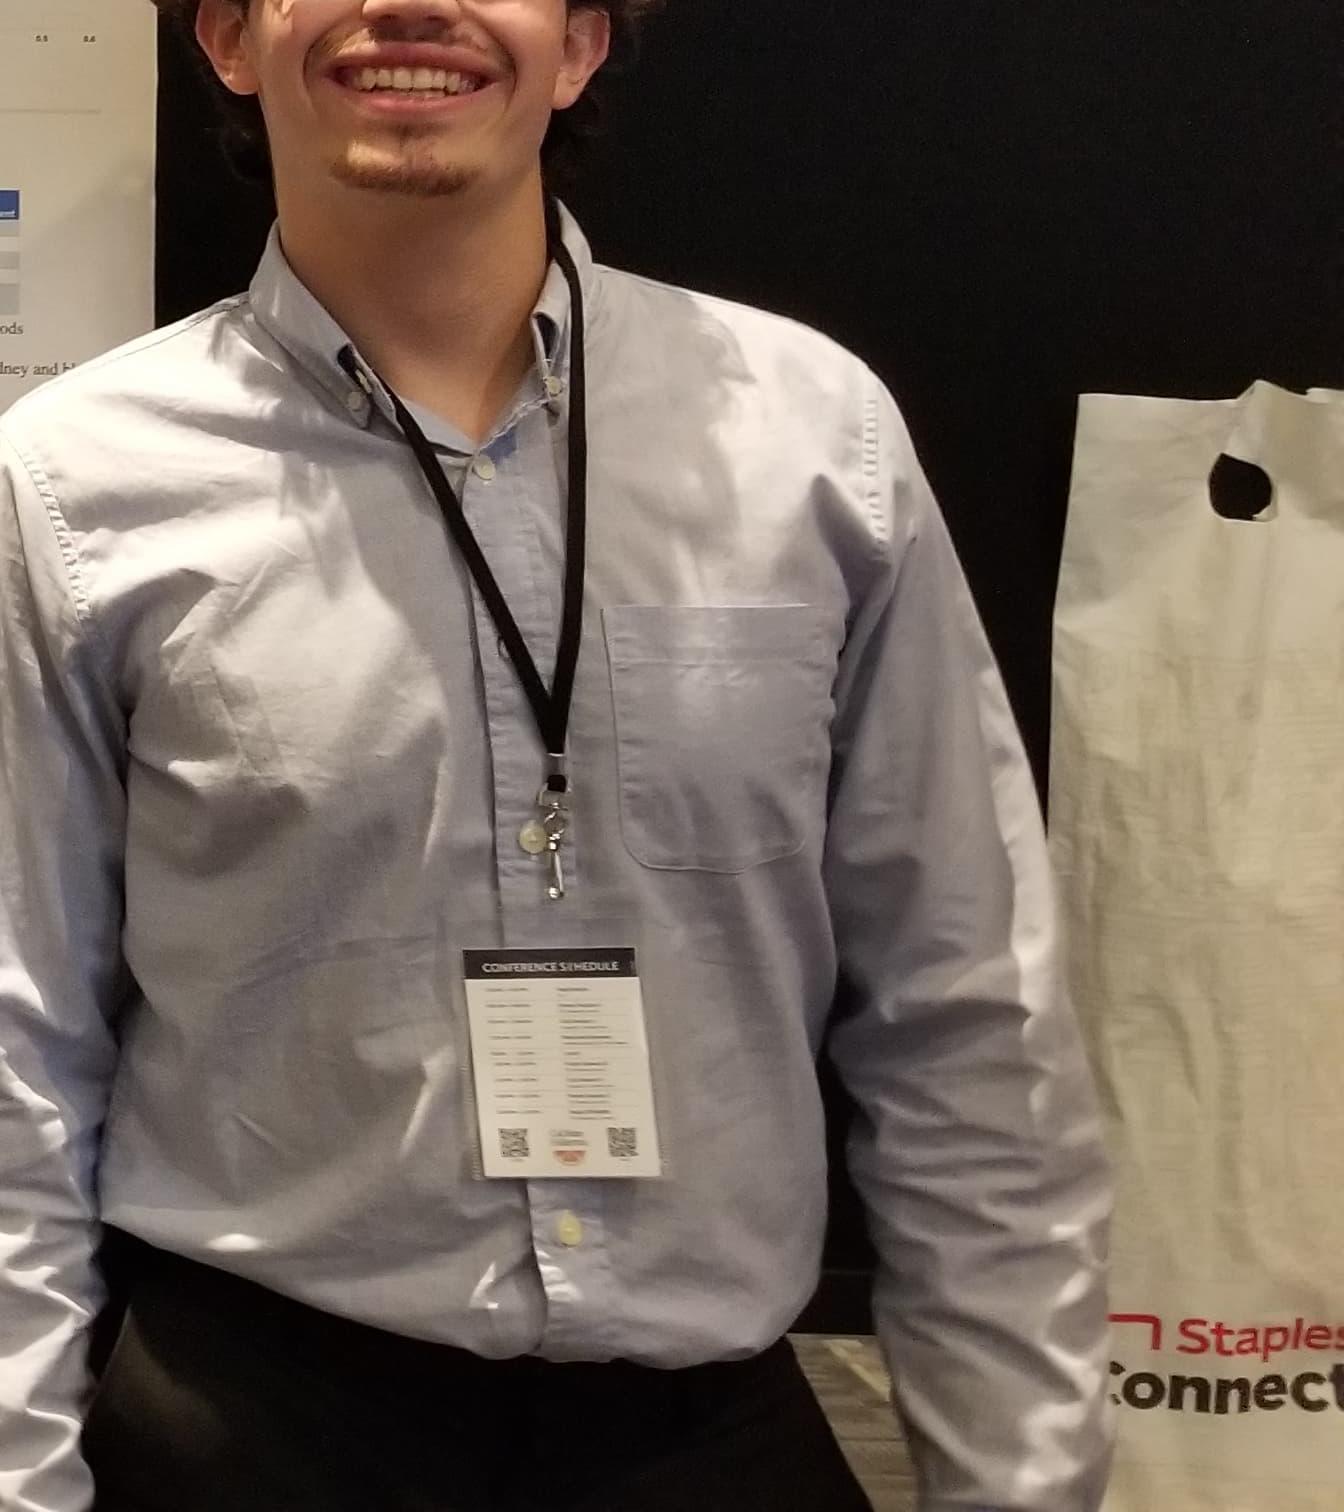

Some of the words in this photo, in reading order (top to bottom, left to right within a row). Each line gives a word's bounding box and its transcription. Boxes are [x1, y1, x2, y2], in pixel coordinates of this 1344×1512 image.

[481, 961, 557, 973] CONFERENCE
[559, 960, 620, 972] SCHEDULE
[1109, 1361, 1344, 1415] onnect
